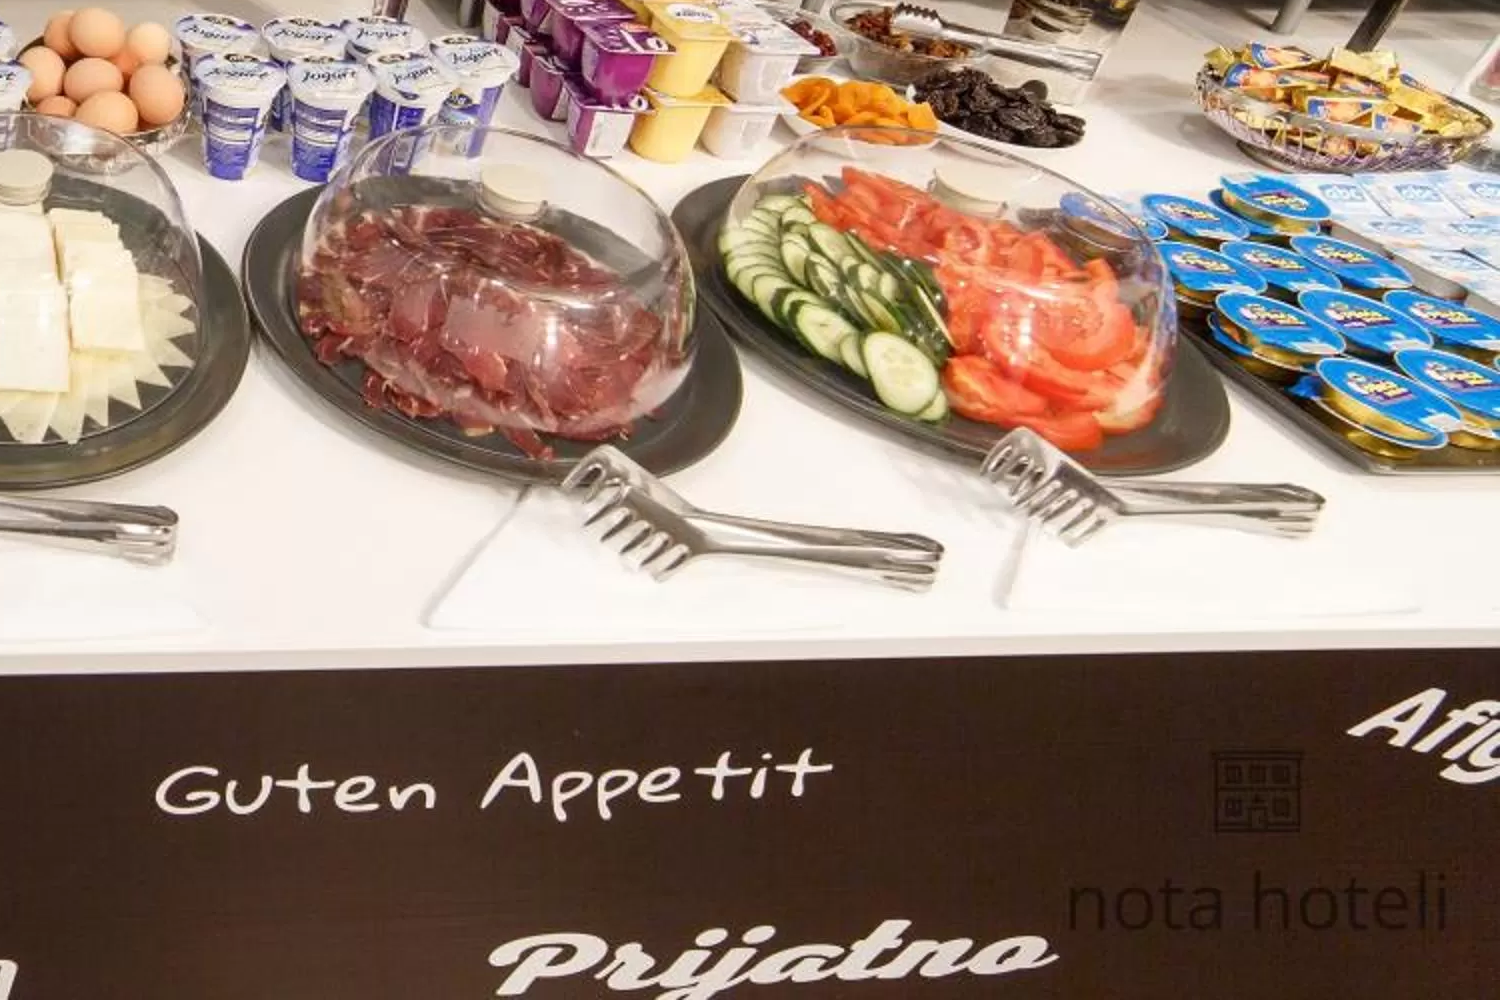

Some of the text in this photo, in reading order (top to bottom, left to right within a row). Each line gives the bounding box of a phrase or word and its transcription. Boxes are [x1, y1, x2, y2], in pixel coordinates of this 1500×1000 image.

[155, 746, 834, 822] Guten Appetit
[487, 919, 1060, 1000] Prijatno
